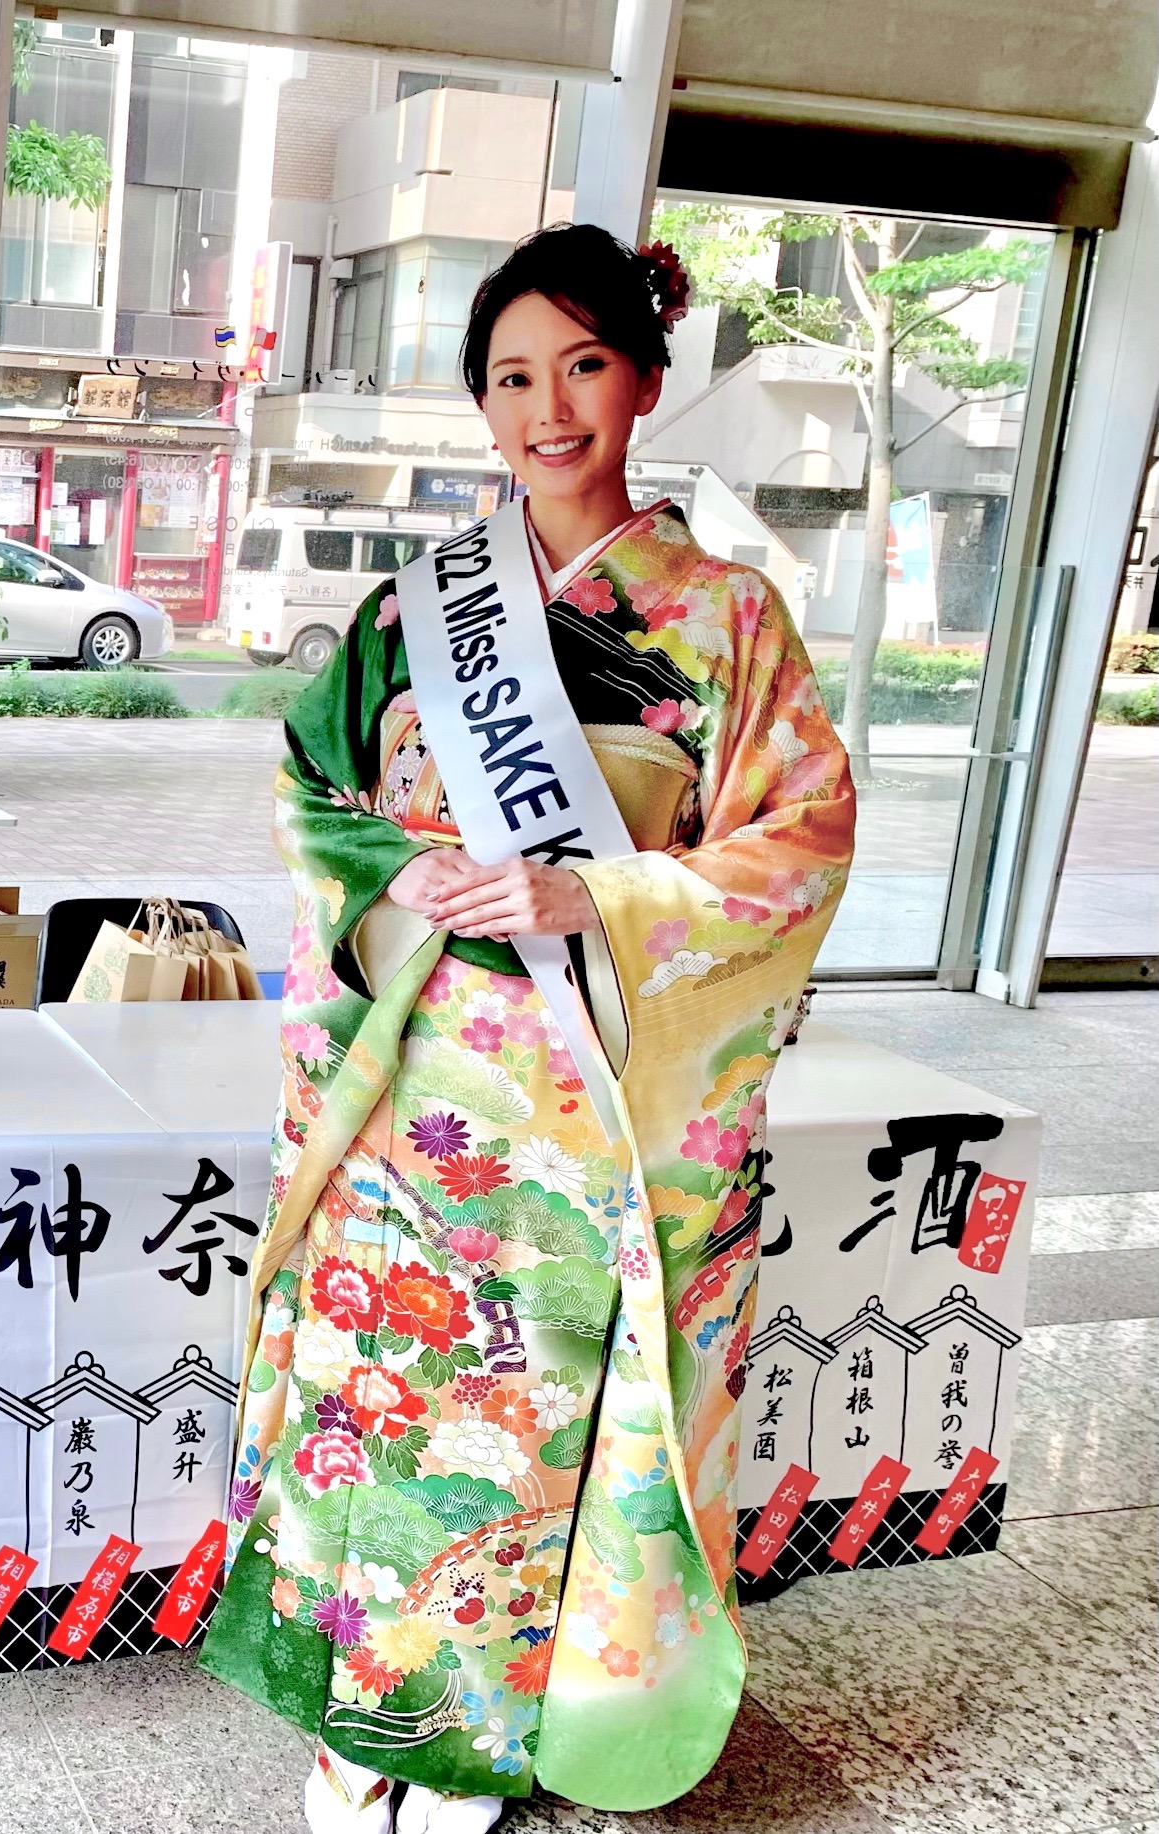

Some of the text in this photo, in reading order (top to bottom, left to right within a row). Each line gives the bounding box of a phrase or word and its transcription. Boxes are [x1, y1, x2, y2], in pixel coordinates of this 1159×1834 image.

[443, 581, 507, 683] Miss
[462, 677, 571, 832] SAKE
[838, 1111, 1005, 1255] 酒
[971, 1182, 1020, 1269] かながわ
[843, 1346, 874, 1450] 箱根山
[934, 1343, 971, 1471] 曽我の誉
[171, 1408, 207, 1484] 盛升
[757, 1484, 802, 1556] 松田町
[848, 1477, 892, 1544] 大井町
[936, 1468, 981, 1534] 大井町
[66, 1543, 128, 1647] 相模原市
[177, 1540, 220, 1617] 厚木市
